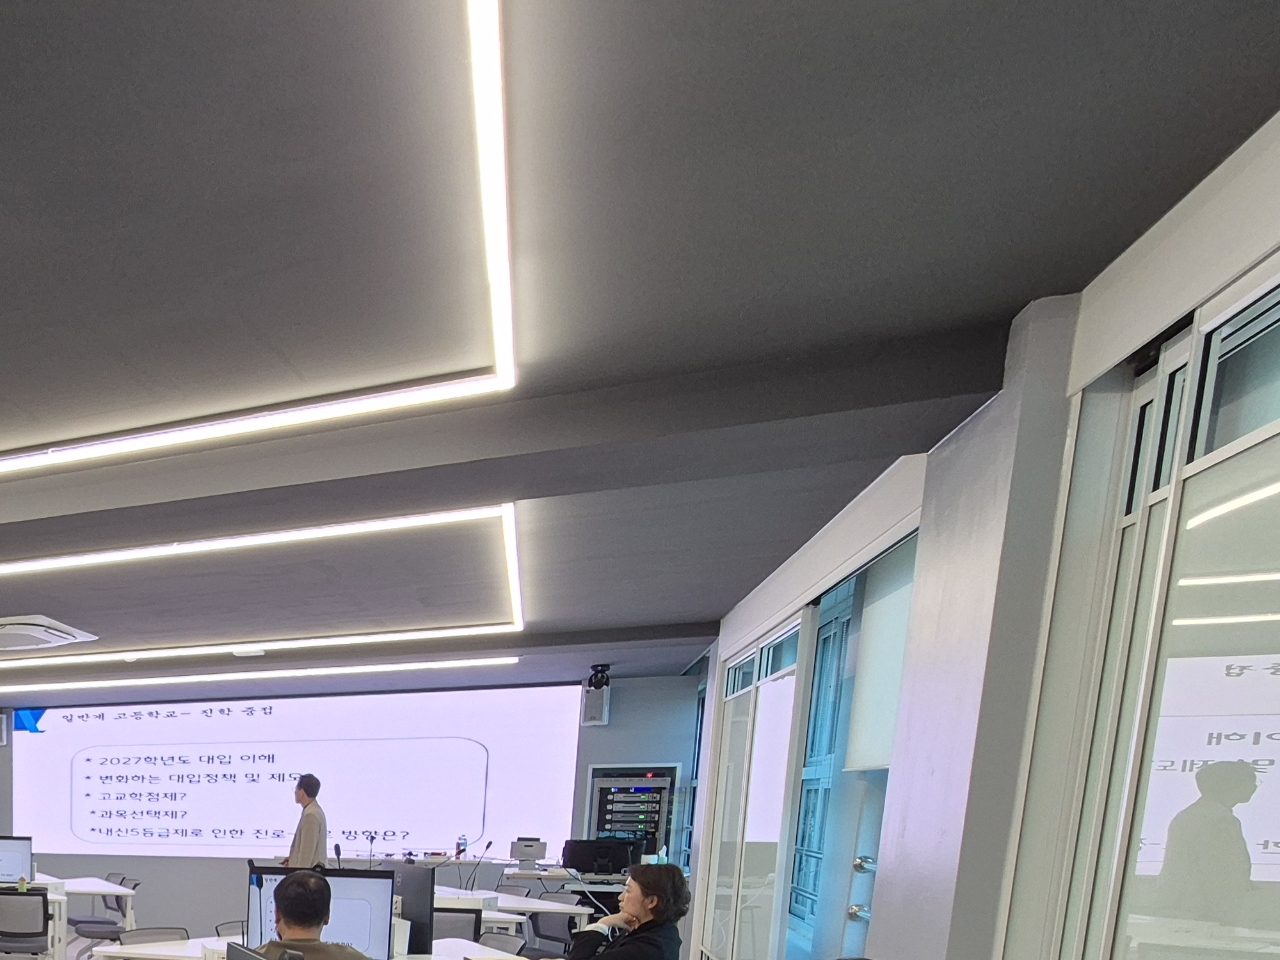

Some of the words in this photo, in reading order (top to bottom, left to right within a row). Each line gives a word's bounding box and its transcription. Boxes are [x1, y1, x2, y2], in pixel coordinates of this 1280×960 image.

[61, 712, 105, 723] 일반계
[200, 707, 233, 718] 진학
[98, 755, 192, 767] 2027학년도
[198, 754, 232, 766] 대입
[239, 753, 276, 764] 이해
[99, 774, 162, 785] 변화하는
[168, 773, 237, 784] 대입정책
[244, 773, 261, 783] 및
[267, 772, 302, 783] 제도
[97, 792, 187, 803] 고교학점제?
[211, 828, 245, 840] 인한
